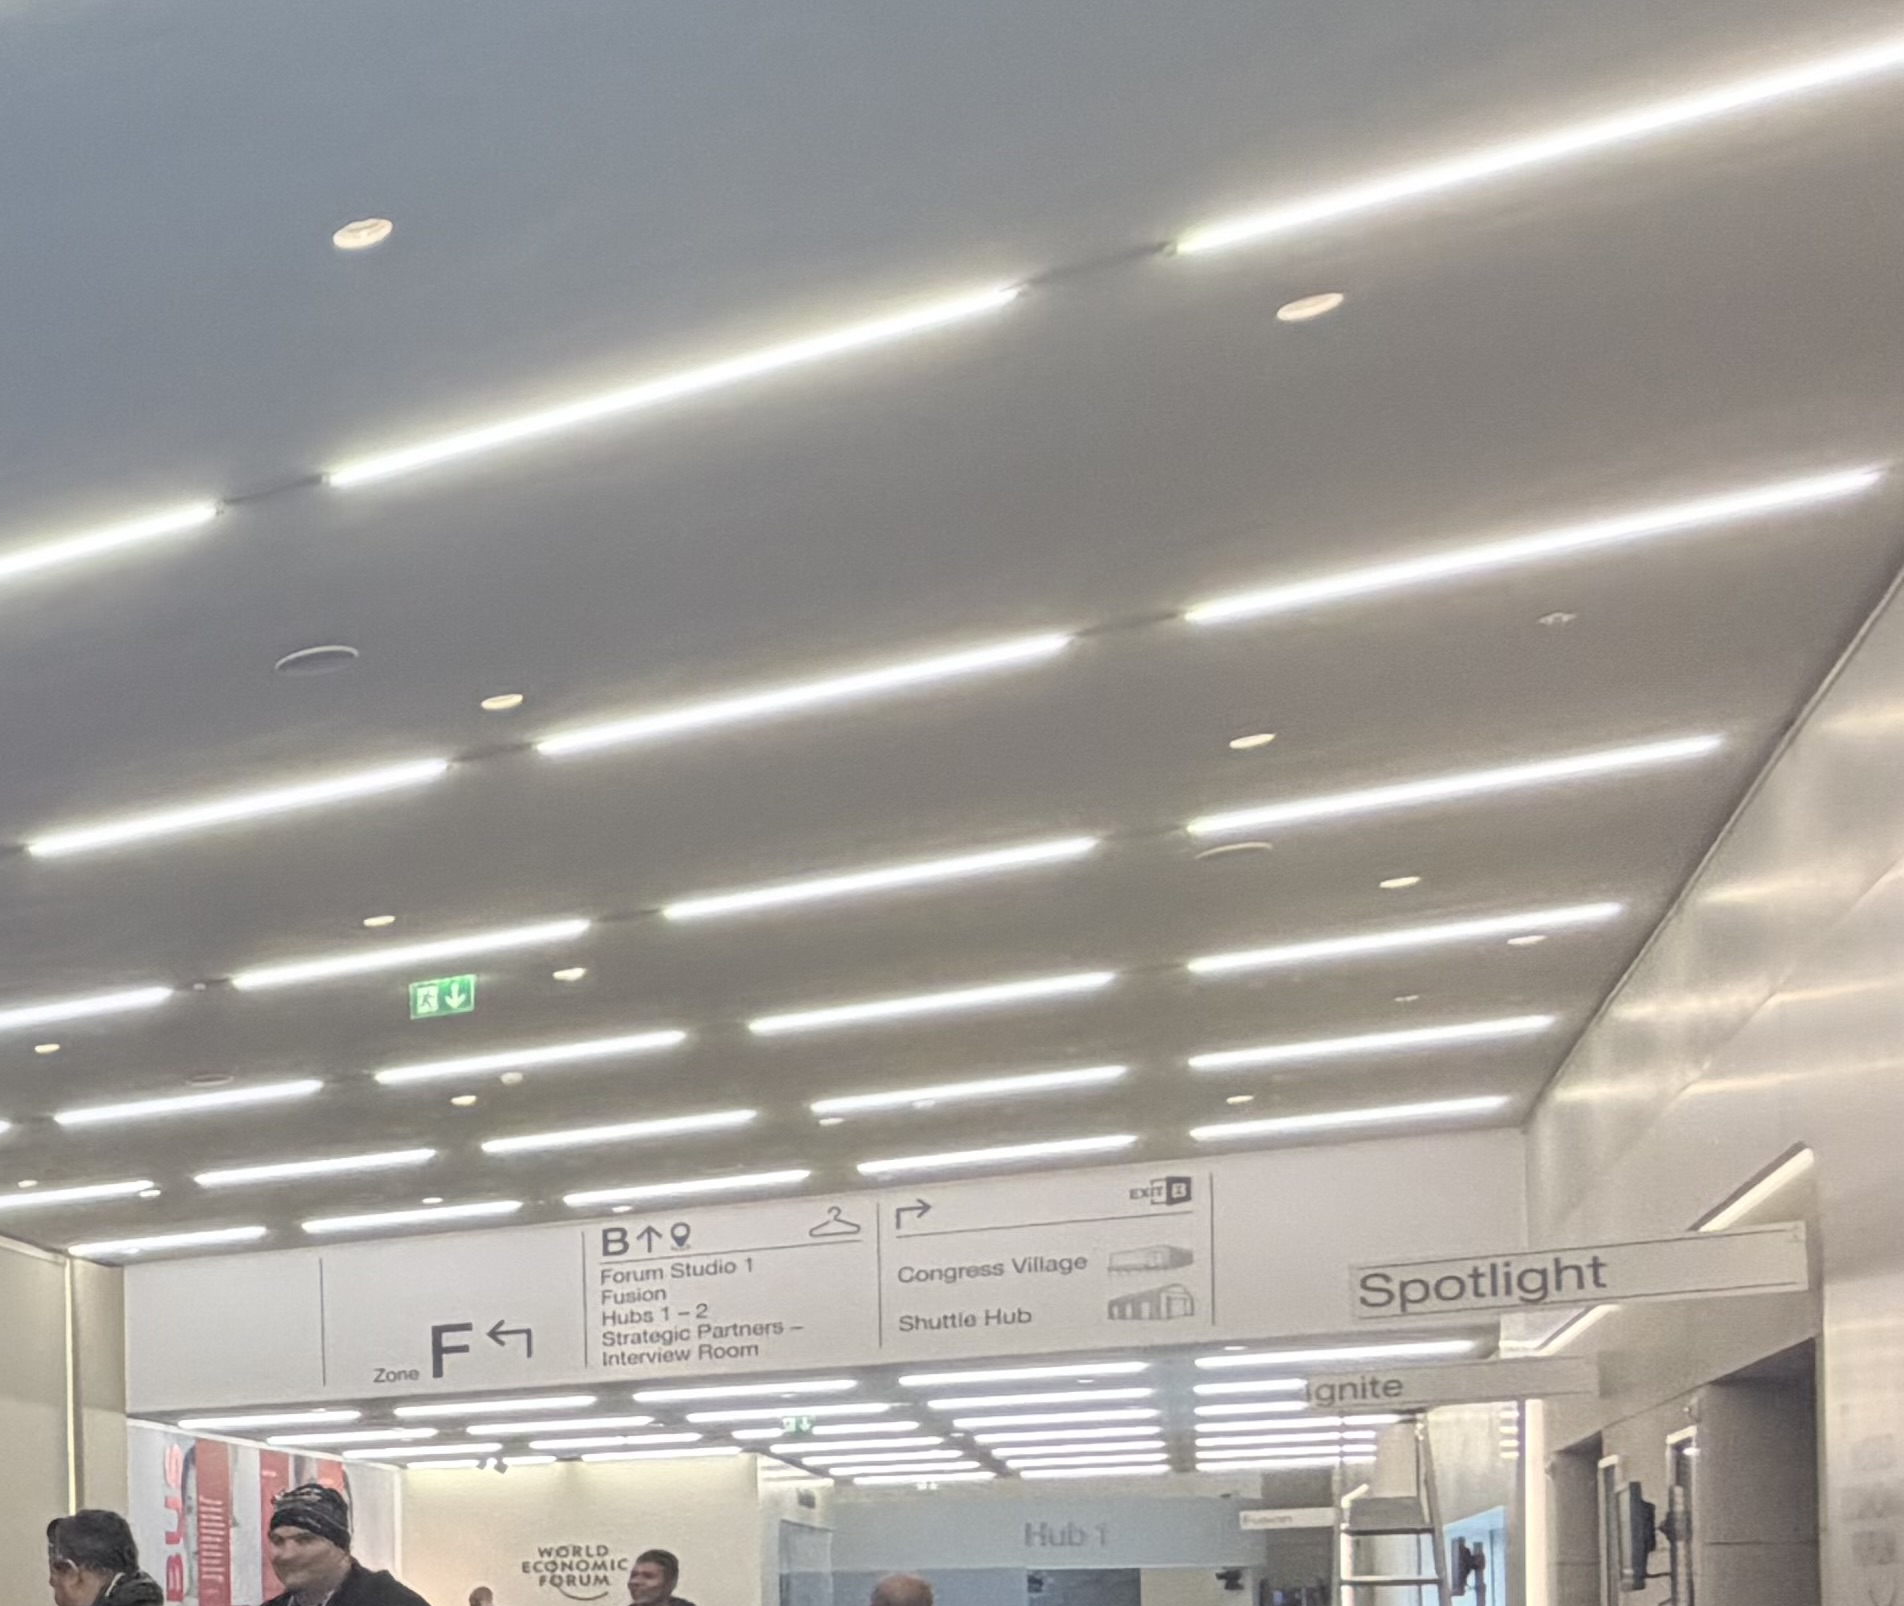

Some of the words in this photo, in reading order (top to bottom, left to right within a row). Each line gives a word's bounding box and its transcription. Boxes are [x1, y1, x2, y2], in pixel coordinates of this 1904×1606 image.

[602, 1227, 630, 1257] B
[600, 1265, 664, 1285] Forum
[671, 1260, 737, 1280] Studio
[744, 1257, 754, 1275] 1
[897, 1260, 1004, 1284] Congress
[1012, 1254, 1088, 1276] Village
[600, 1287, 667, 1305] Fusion
[1359, 1256, 1608, 1313] Spotlight
[602, 1309, 654, 1327] Hubs
[661, 1306, 671, 1323] 1
[695, 1303, 709, 1320] 2
[899, 1311, 977, 1332] Shuttle
[985, 1307, 1033, 1327] Hub
[602, 1325, 692, 1348] Strategic
[698, 1320, 784, 1340] Partners
[373, 1366, 420, 1384] Zone
[431, 1322, 473, 1378] F
[602, 1346, 691, 1367] Interview
[698, 1342, 760, 1360] Room
[1025, 1522, 1087, 1547] Hub
[537, 1544, 609, 1558] WORLD
[522, 1558, 629, 1574] ECONOMIC
[538, 1573, 610, 1588] FORUM
